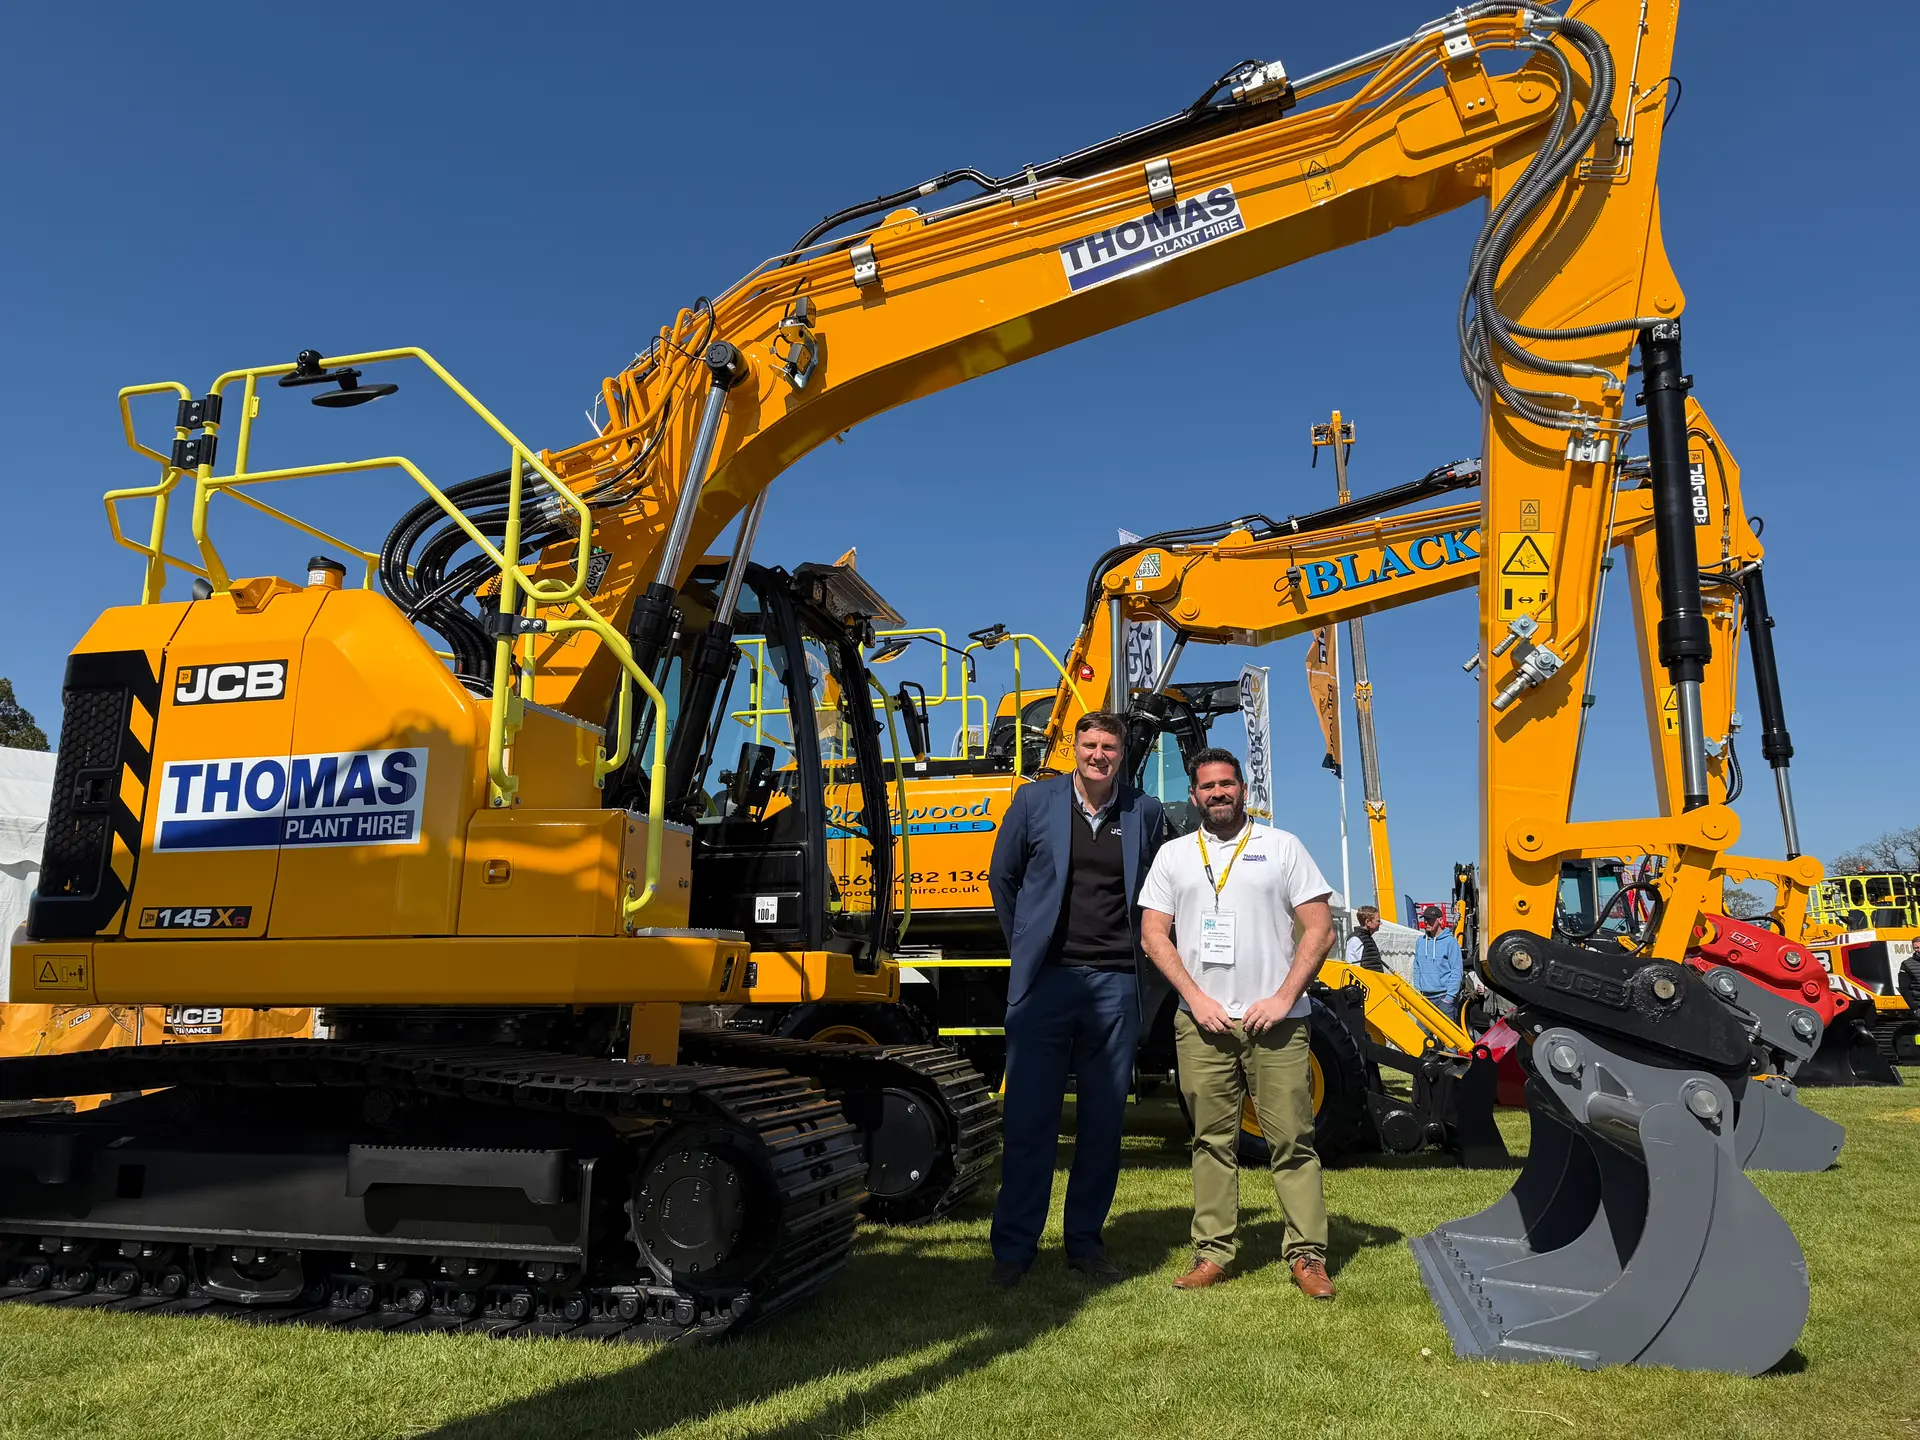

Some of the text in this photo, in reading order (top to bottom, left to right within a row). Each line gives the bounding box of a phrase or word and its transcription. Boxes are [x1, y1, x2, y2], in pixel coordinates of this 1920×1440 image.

[1061, 187, 1236, 270] THOMAS
[1154, 217, 1240, 257] PLANT HIRE
[1300, 525, 1480, 599] BLACK
[176, 663, 284, 702] JCB
[168, 751, 417, 814] THOMAS
[285, 814, 407, 839] PLANT HIRE
[910, 821, 981, 833] HIRE
[757, 908, 770, 920] 100
[1730, 931, 1760, 949] GTX
[69, 1011, 91, 1028] JCB
[166, 1008, 222, 1024] JCB
